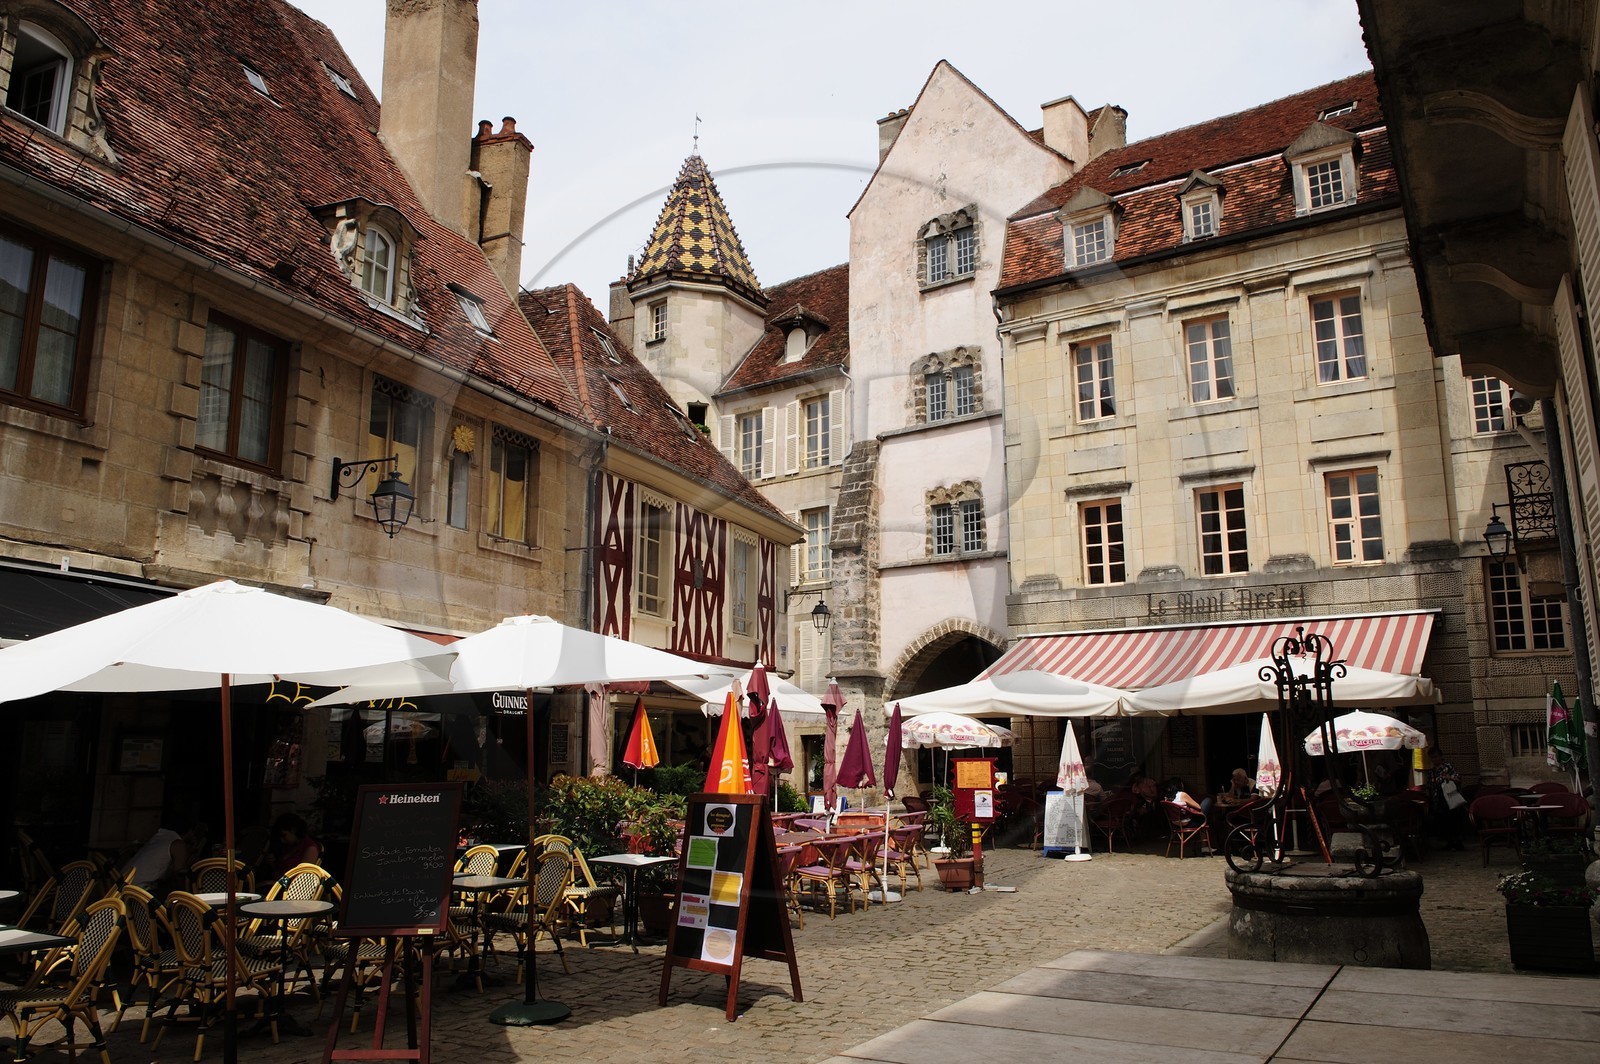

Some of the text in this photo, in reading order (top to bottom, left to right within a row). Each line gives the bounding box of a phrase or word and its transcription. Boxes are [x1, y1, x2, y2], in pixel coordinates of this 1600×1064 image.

[1147, 594, 1167, 616] Le
[1177, 591, 1225, 614] Mont
[492, 692, 528, 709] GUINNES
[389, 793, 441, 804] Heineken
